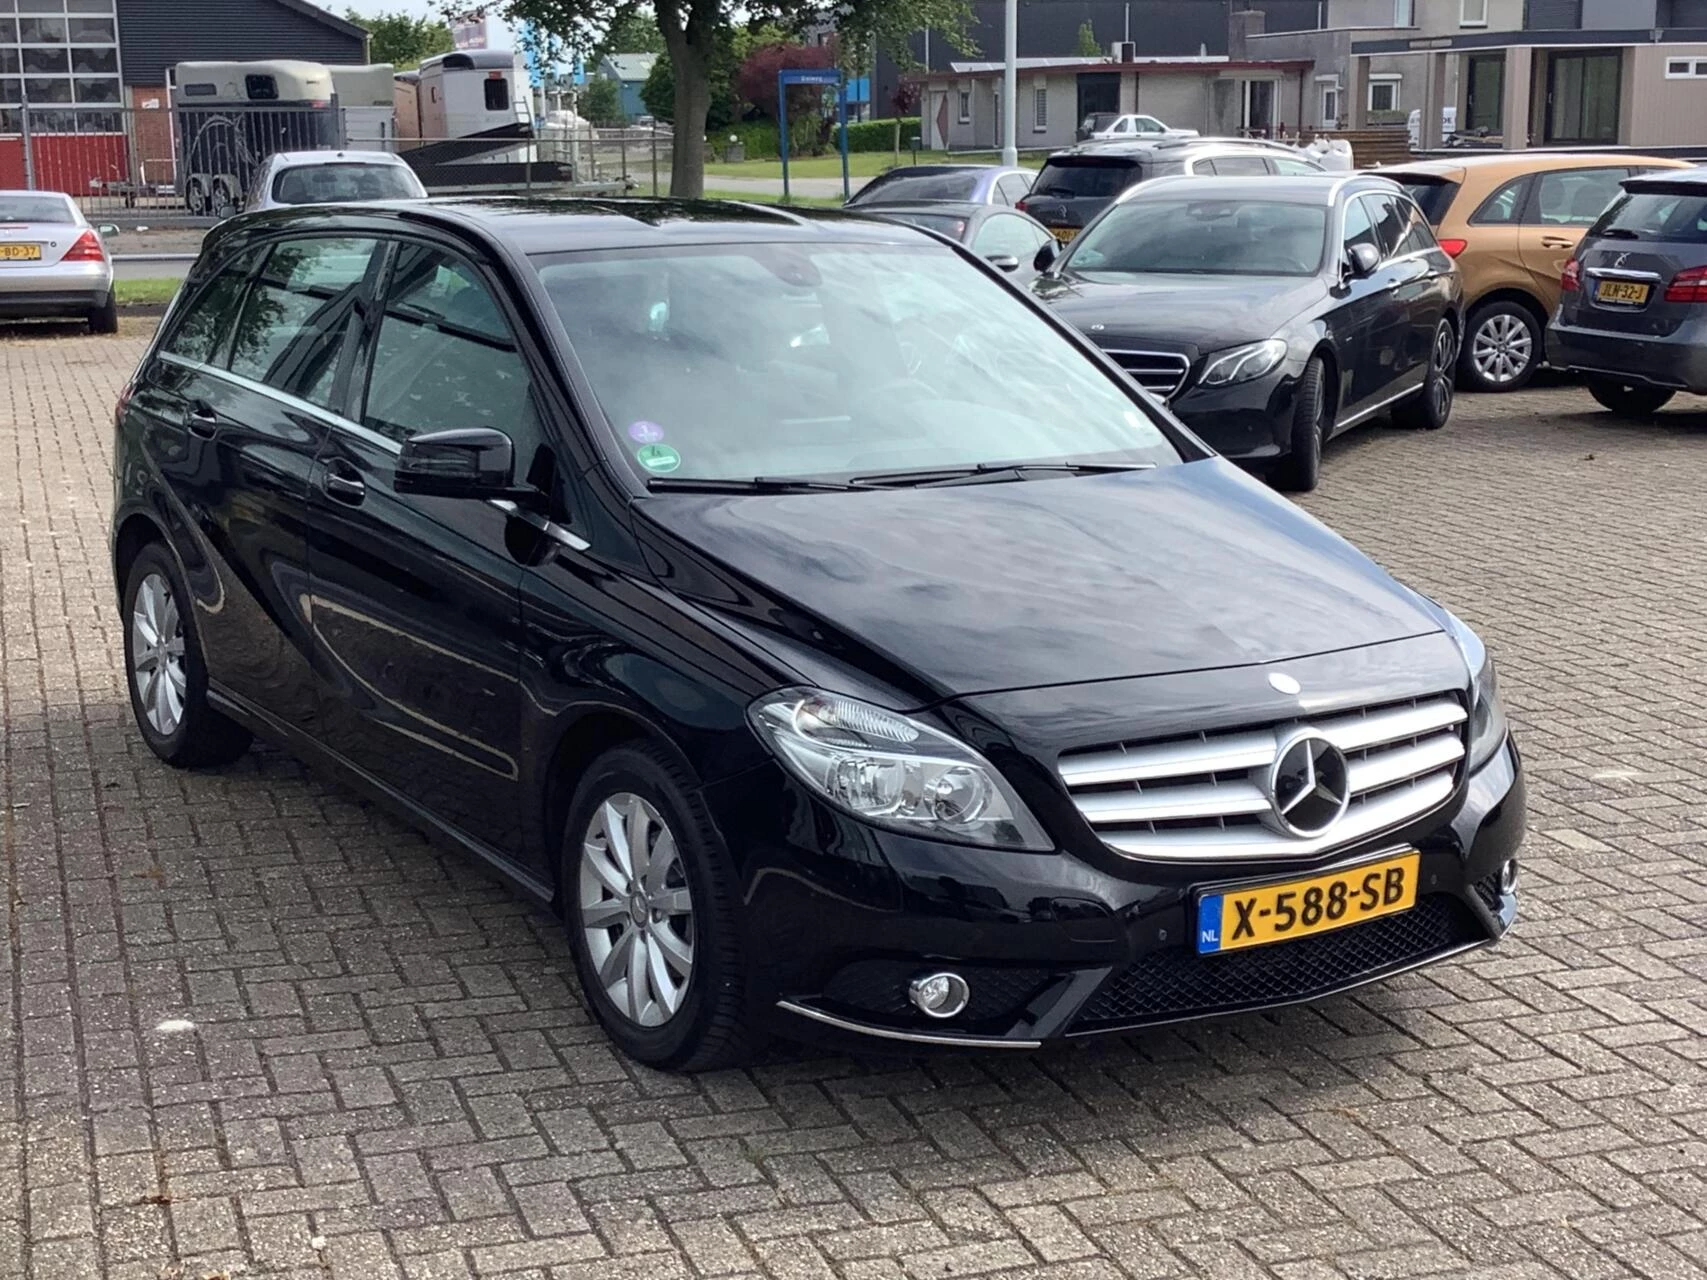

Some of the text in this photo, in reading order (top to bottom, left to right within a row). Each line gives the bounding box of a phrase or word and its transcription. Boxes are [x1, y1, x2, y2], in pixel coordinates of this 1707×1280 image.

[1600, 283, 1643, 299] JLN-32-J
[1231, 866, 1405, 941] X-588-SB
[1201, 929, 1219, 943] NL
